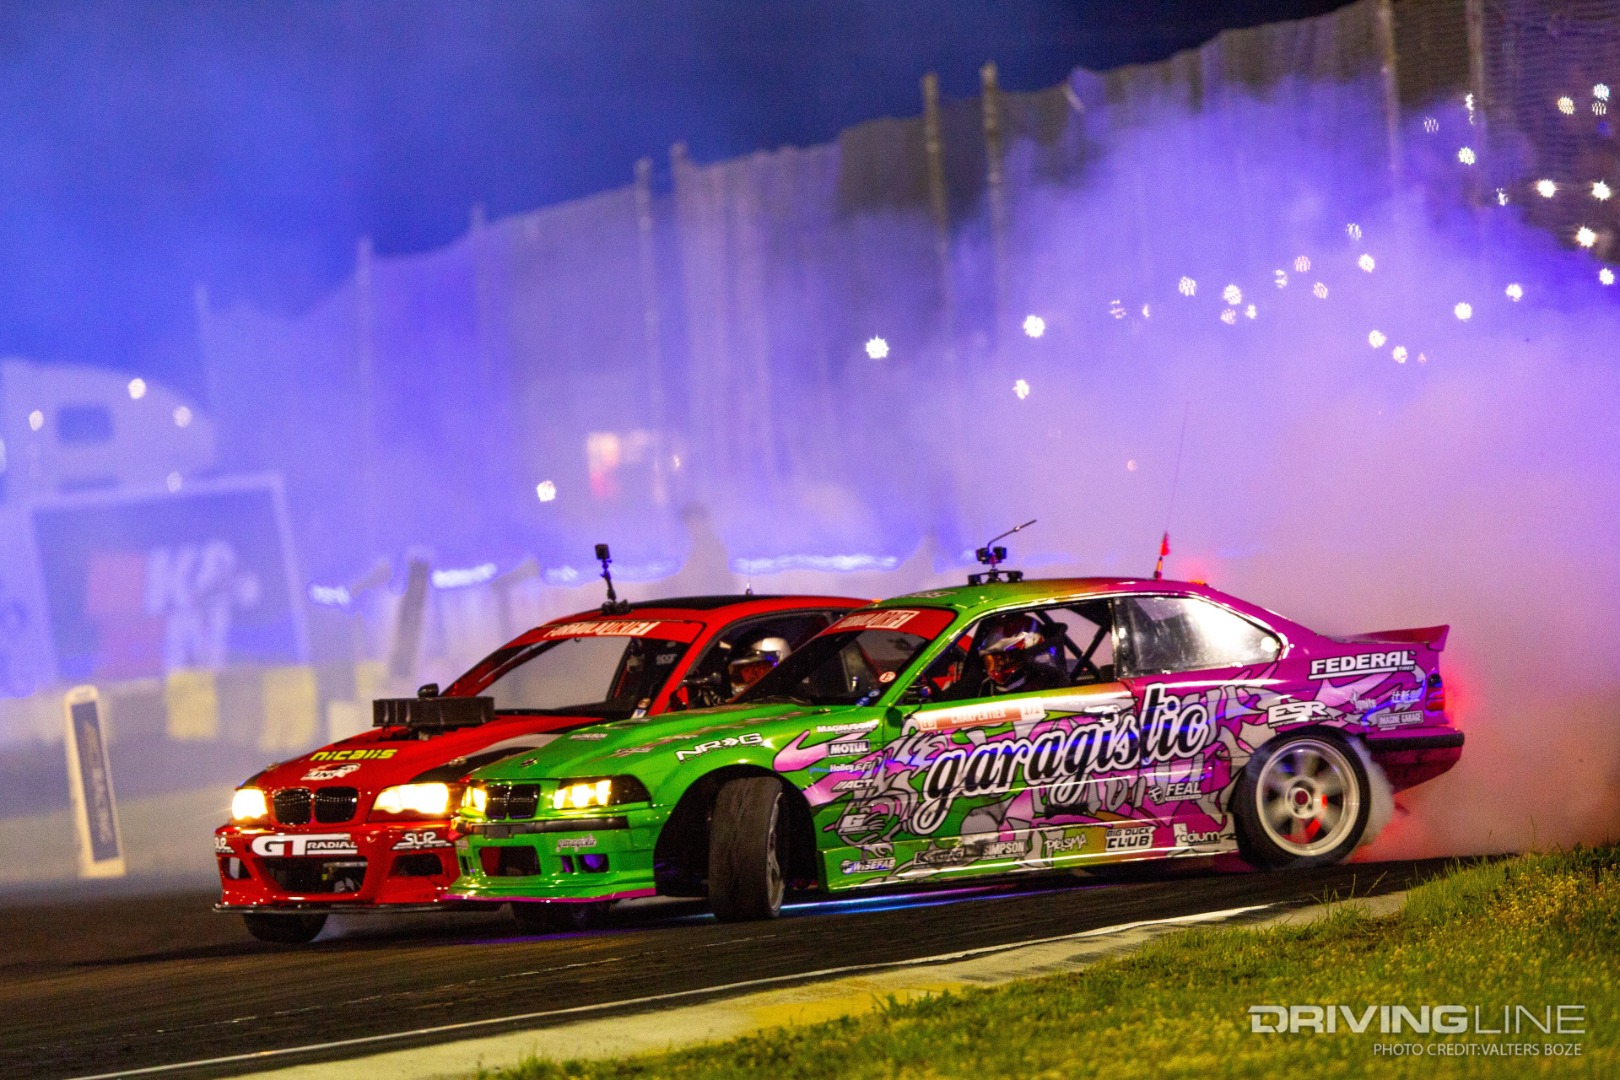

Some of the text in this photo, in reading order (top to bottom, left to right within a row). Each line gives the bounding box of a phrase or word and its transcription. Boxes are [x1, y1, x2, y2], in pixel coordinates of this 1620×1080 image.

[1311, 650, 1415, 674] FEDERAL
[1268, 701, 1328, 724] ESR
[830, 742, 868, 754] MOTUL
[912, 682, 1209, 835] garagistic
[1166, 782, 1201, 796] FEAL
[1107, 827, 1150, 837] BIG DUCK
[252, 834, 358, 856] GT RADIAL
[983, 842, 1025, 856] SIMPSON
[1107, 836, 1150, 848] CLUB
